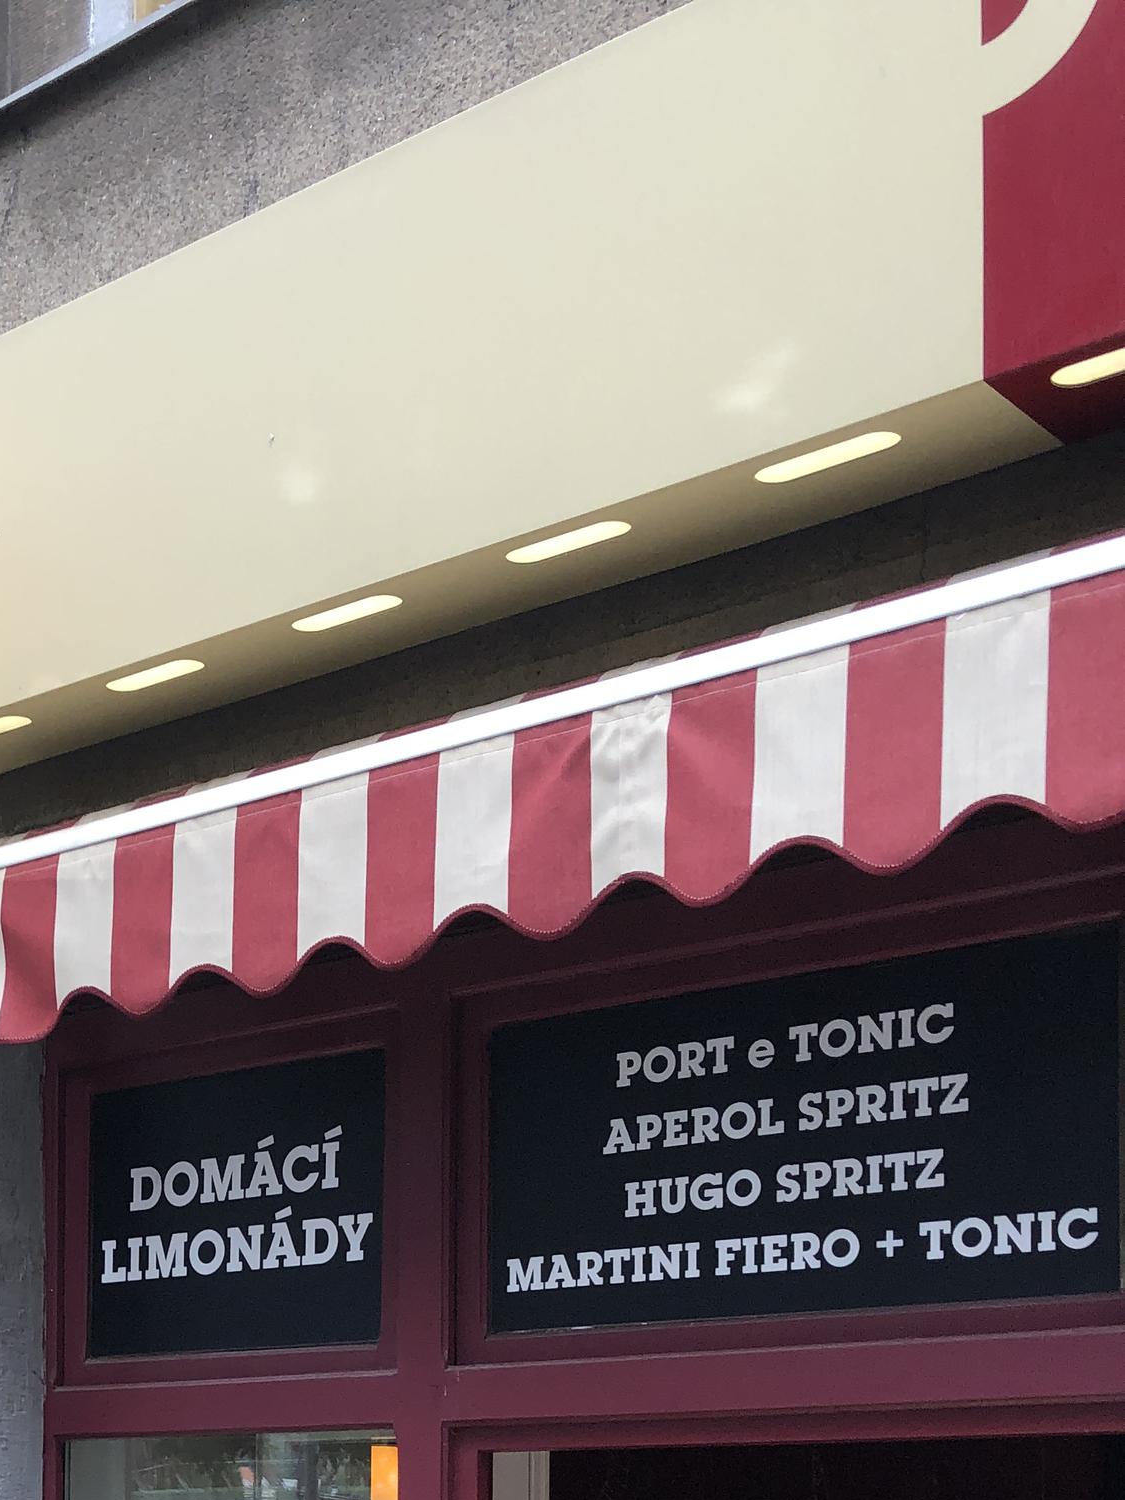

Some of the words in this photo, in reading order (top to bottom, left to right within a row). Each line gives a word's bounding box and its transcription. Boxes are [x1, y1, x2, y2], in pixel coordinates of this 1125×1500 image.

[616, 1036, 735, 1088] PORT
[748, 1039, 775, 1068] e
[789, 1002, 954, 1062] TONIC
[602, 1098, 784, 1155] APEROL
[798, 1073, 969, 1131] SPRITZ
[130, 1125, 342, 1211] DOMÁCÍ
[624, 1169, 761, 1217] HUGO
[776, 1148, 944, 1202] SPRITZ
[101, 1205, 373, 1284] LIMONÁDY
[506, 1241, 700, 1292] MARTINI
[715, 1228, 860, 1276] FIERO
[919, 1207, 1098, 1260] TONIC
